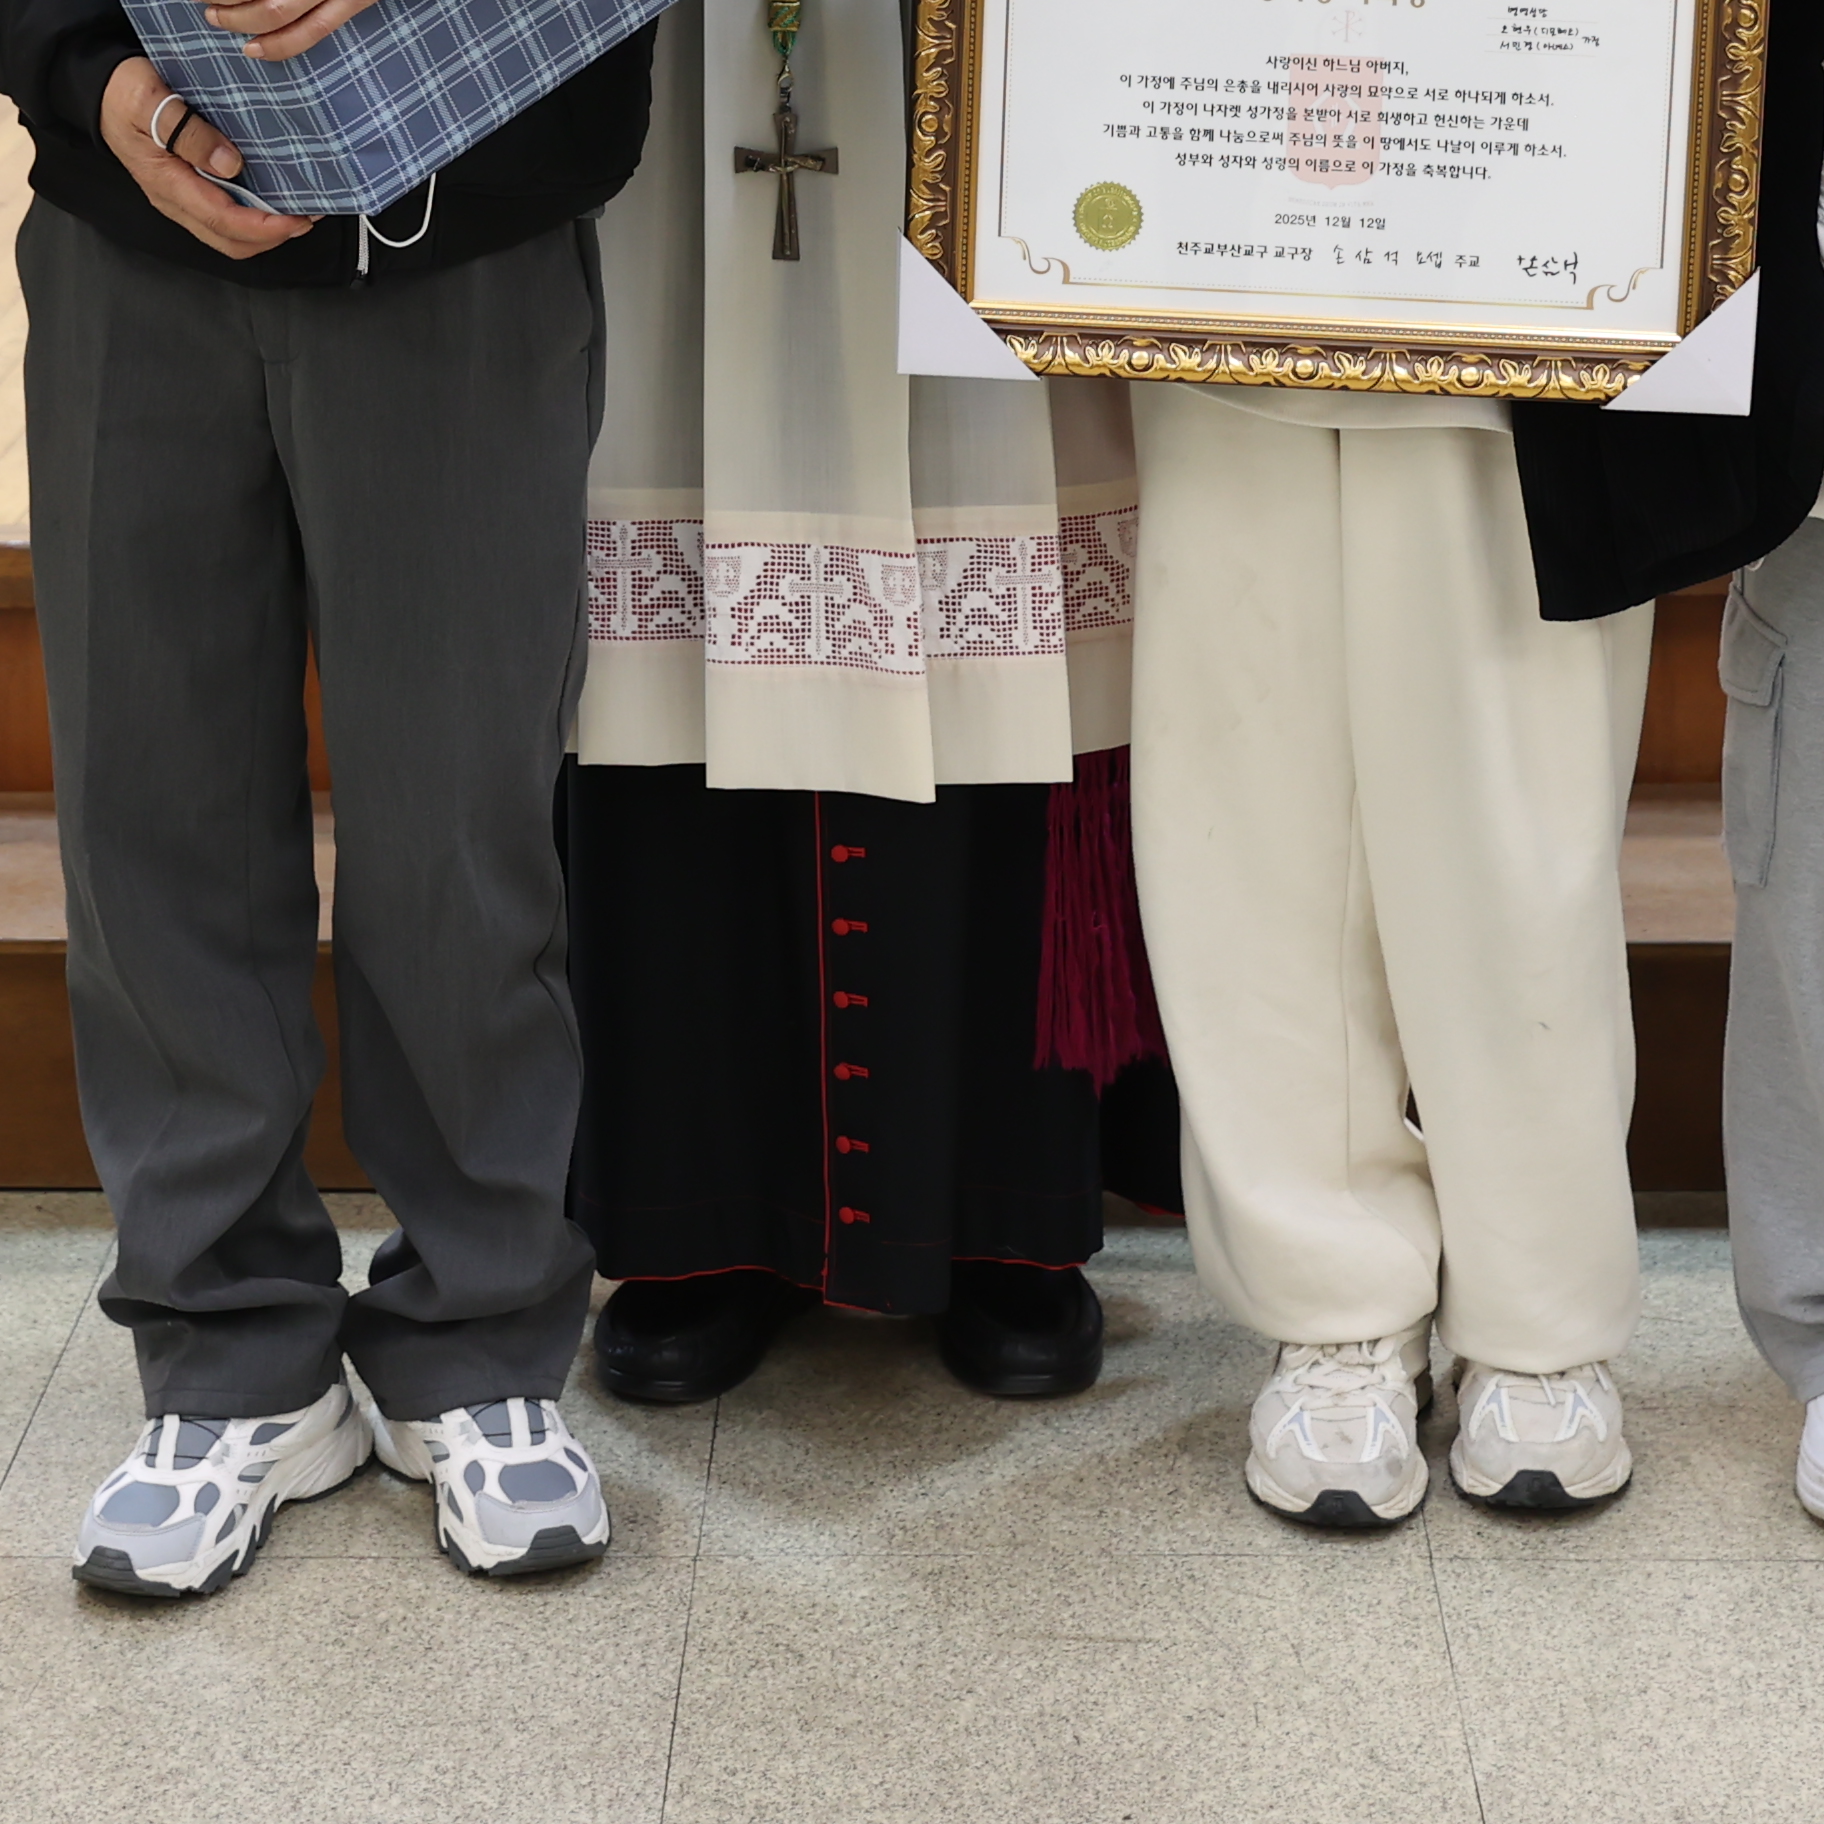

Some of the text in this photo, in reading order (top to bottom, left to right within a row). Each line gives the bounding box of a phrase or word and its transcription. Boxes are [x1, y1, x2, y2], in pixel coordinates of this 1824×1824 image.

[1265, 55, 1409, 76] 사랑이신 하느님 아버지,
[1120, 74, 1555, 107] 이 가정에 주님의 은총을 내리시어 사랑의 묘약으로 서로 하나되게 하소서.
[1142, 100, 1529, 132] 이 가정이 나자렛 성가정을 본받아 서로 희생하고 헌신하는 가운데
[1103, 123, 1567, 159] 기쁨과 고통을 함께 나눔으로써 주님의 뜻을 이 땅에서도 나날이 이루게 하소서.
[1175, 152, 1492, 181] 성부와 성자와 성령의 이름으로 이 가정을 축복합니다.
[1274, 213, 1386, 230] 2025년 12월 12일
[1176, 241, 1268, 259] 천주교부산교구
[1273, 245, 1313, 262] 교구장
[1454, 254, 1480, 268] 주교
